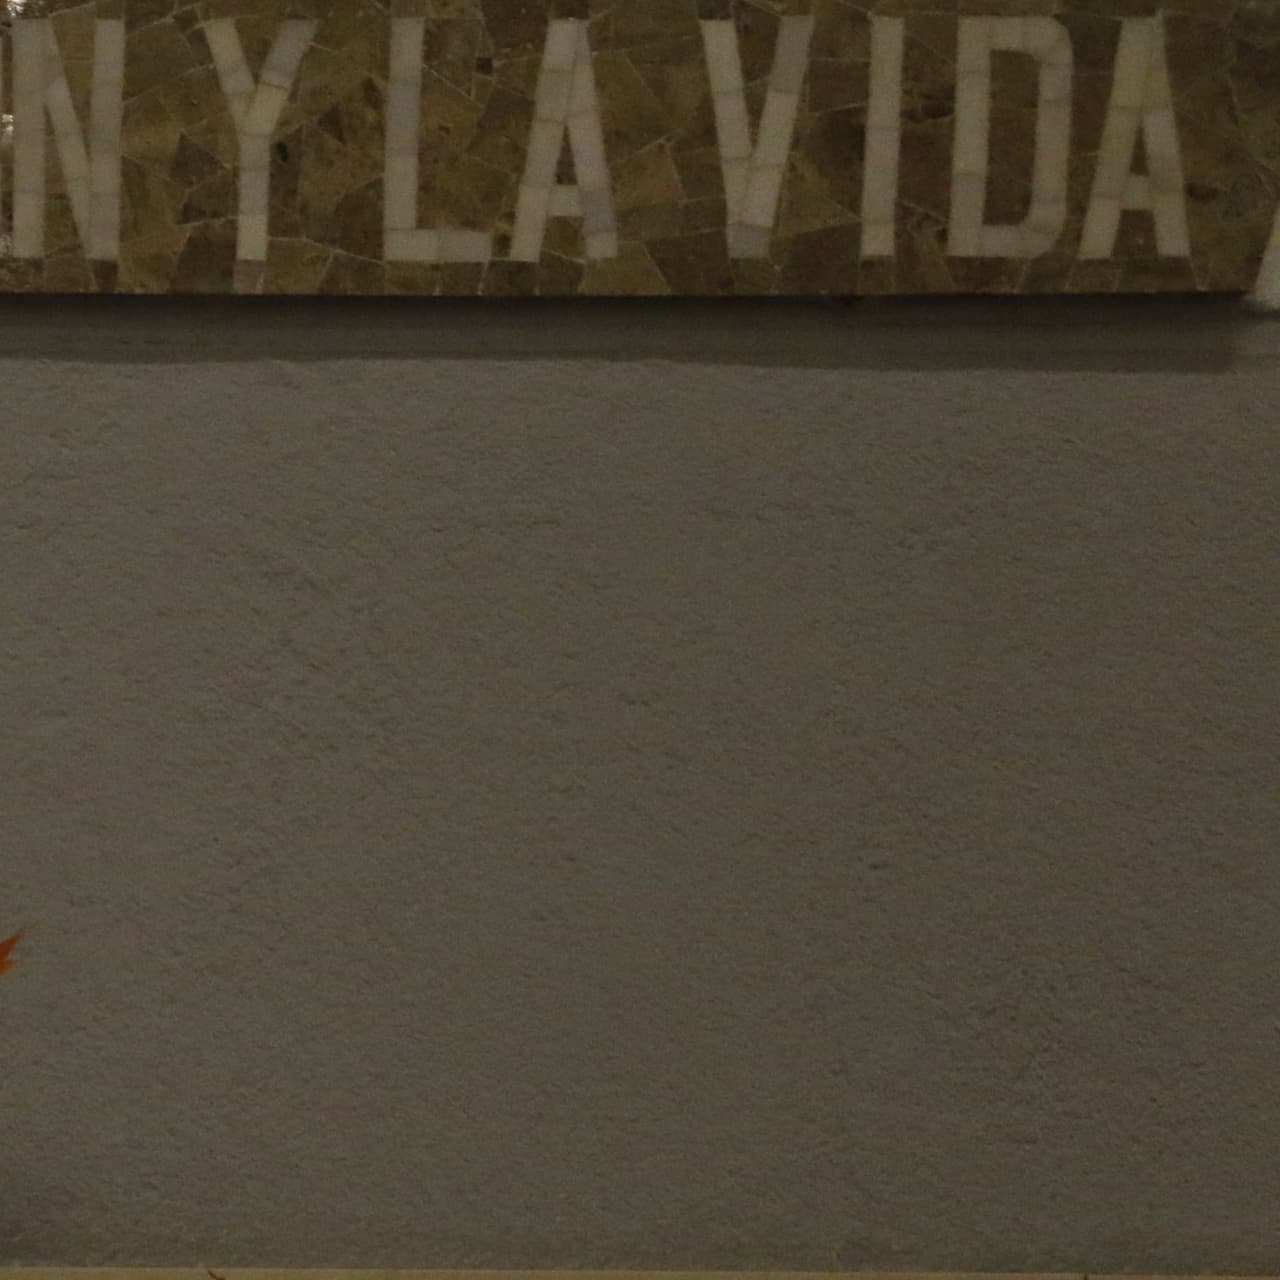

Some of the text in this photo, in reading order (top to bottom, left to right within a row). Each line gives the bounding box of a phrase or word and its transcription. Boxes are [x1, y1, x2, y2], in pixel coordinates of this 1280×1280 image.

[204, 15, 320, 261] Y
[384, 15, 619, 261] LA
[700, 12, 1190, 261] VIDA
